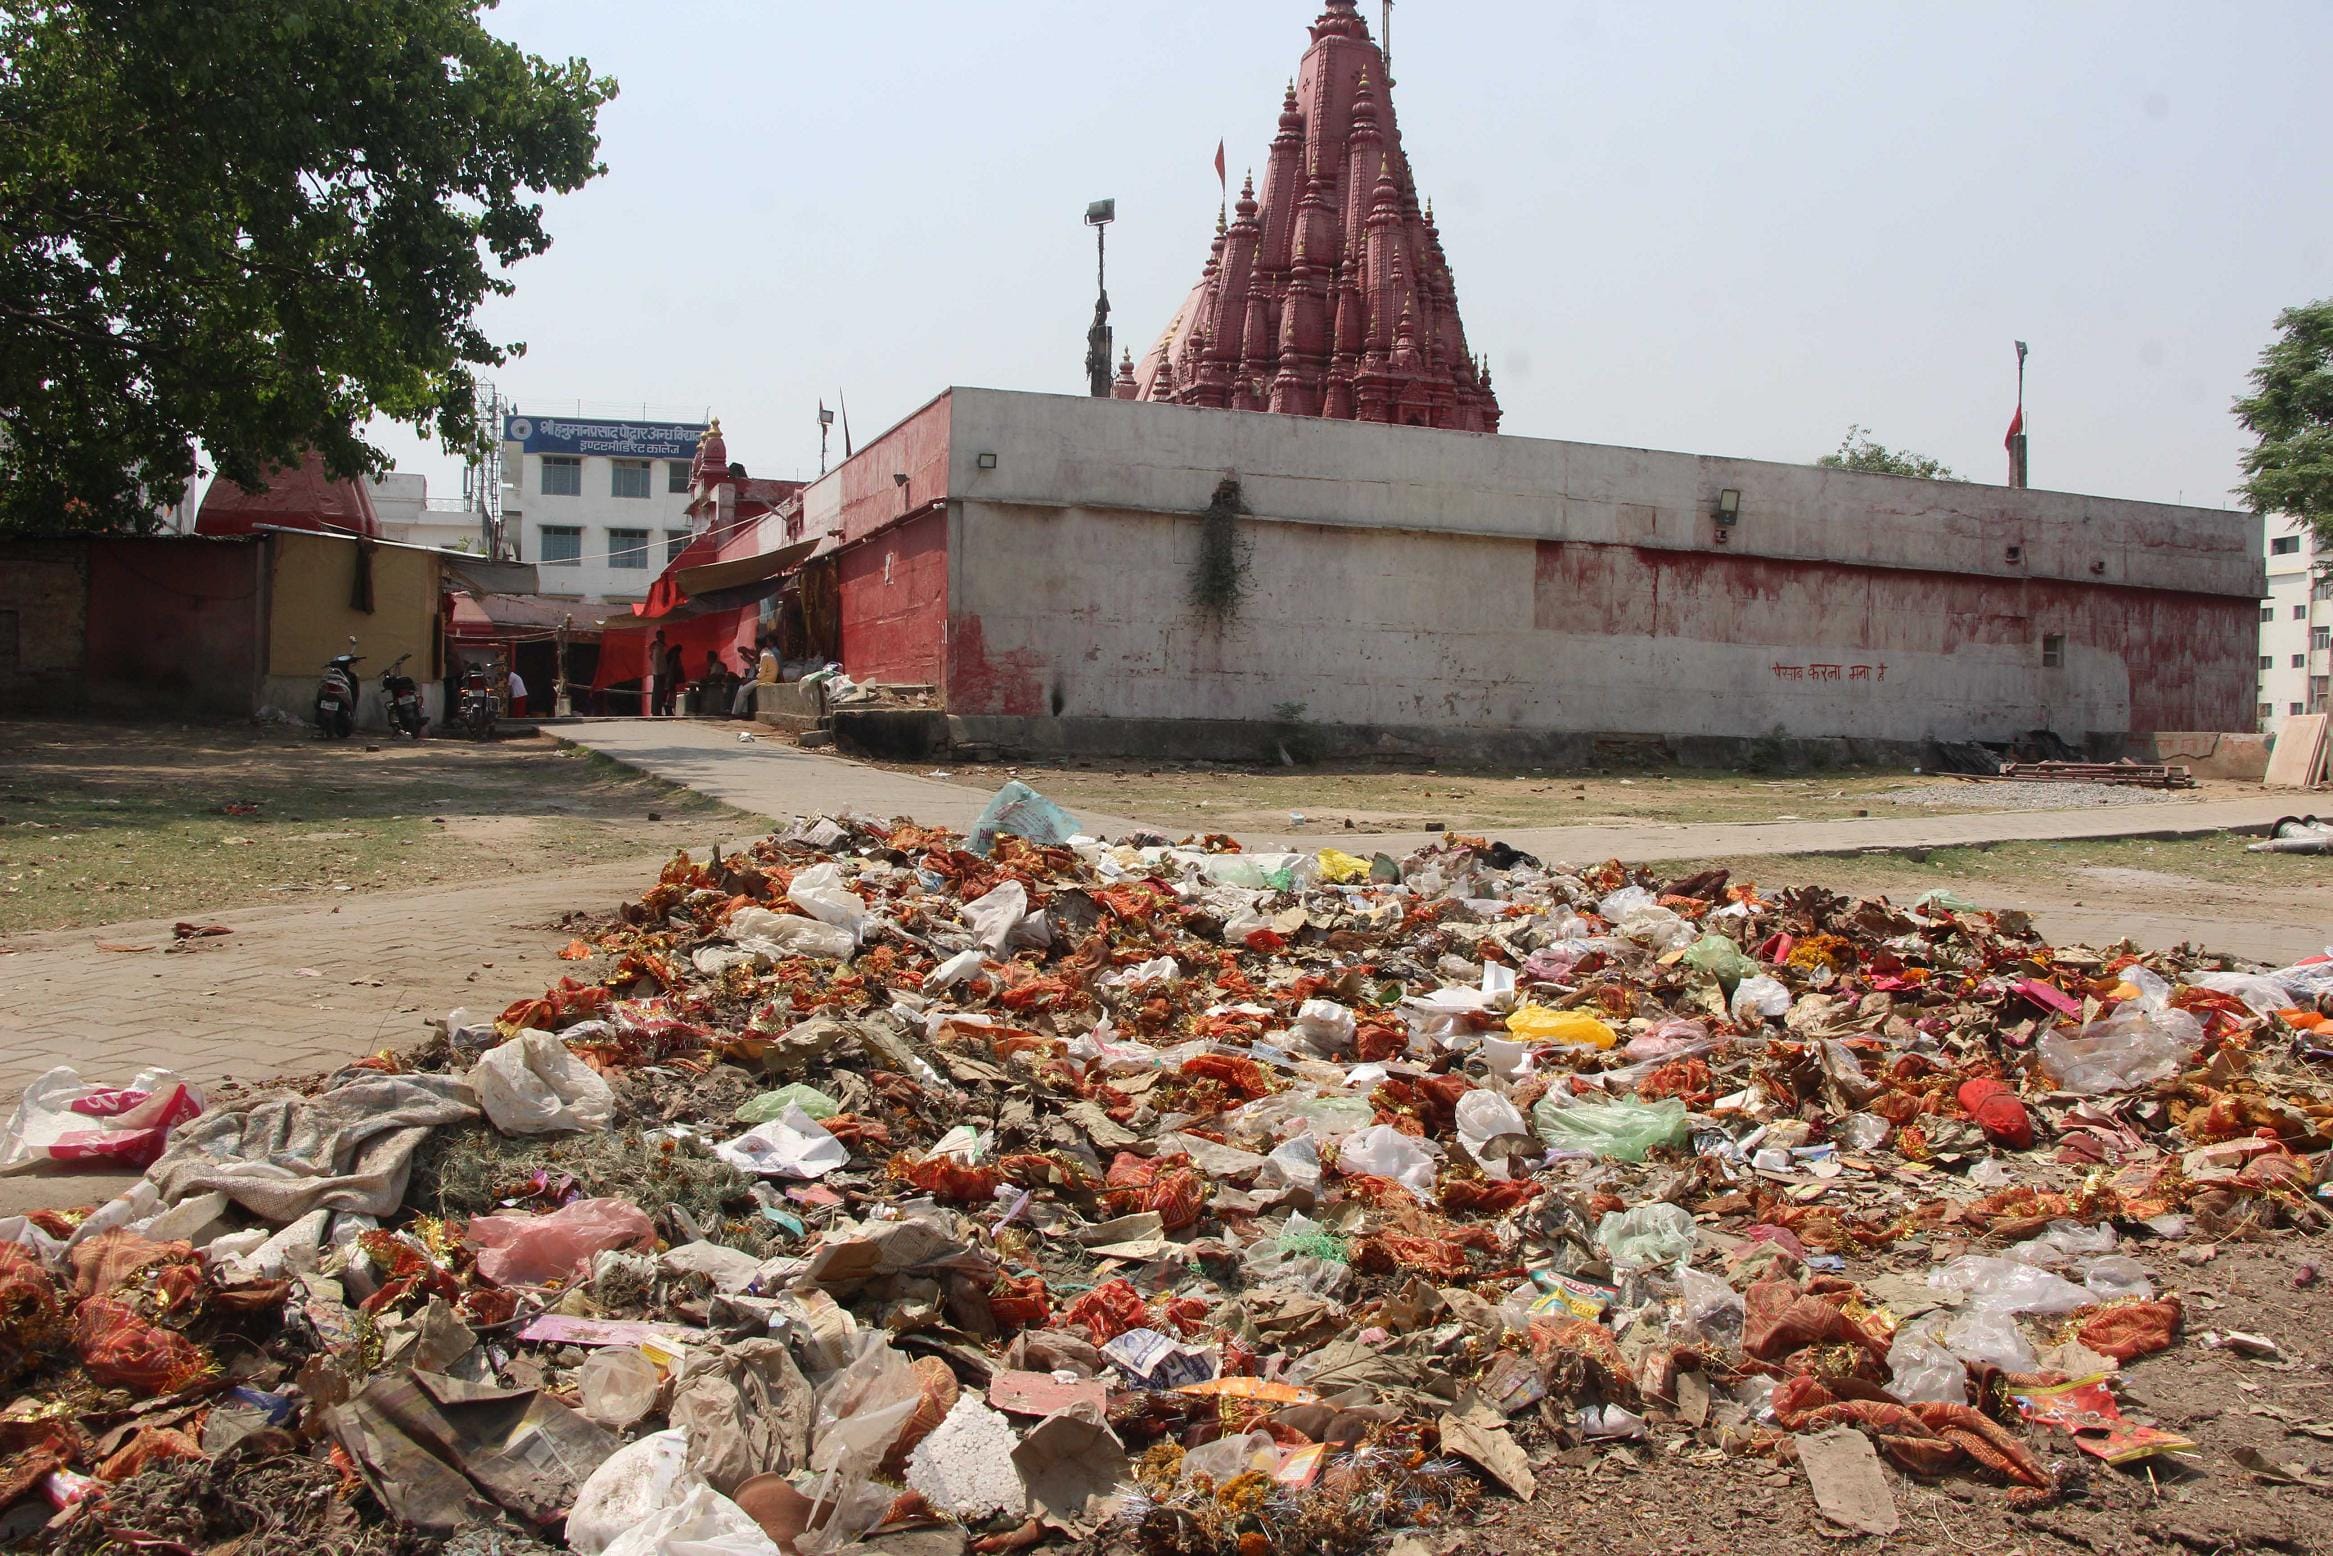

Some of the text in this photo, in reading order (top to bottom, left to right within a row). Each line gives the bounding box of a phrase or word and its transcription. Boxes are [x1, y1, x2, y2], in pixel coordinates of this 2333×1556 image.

[647, 441, 680, 454] कालेज
[1808, 663, 1843, 682] करना
[1849, 665, 1872, 681] मना
